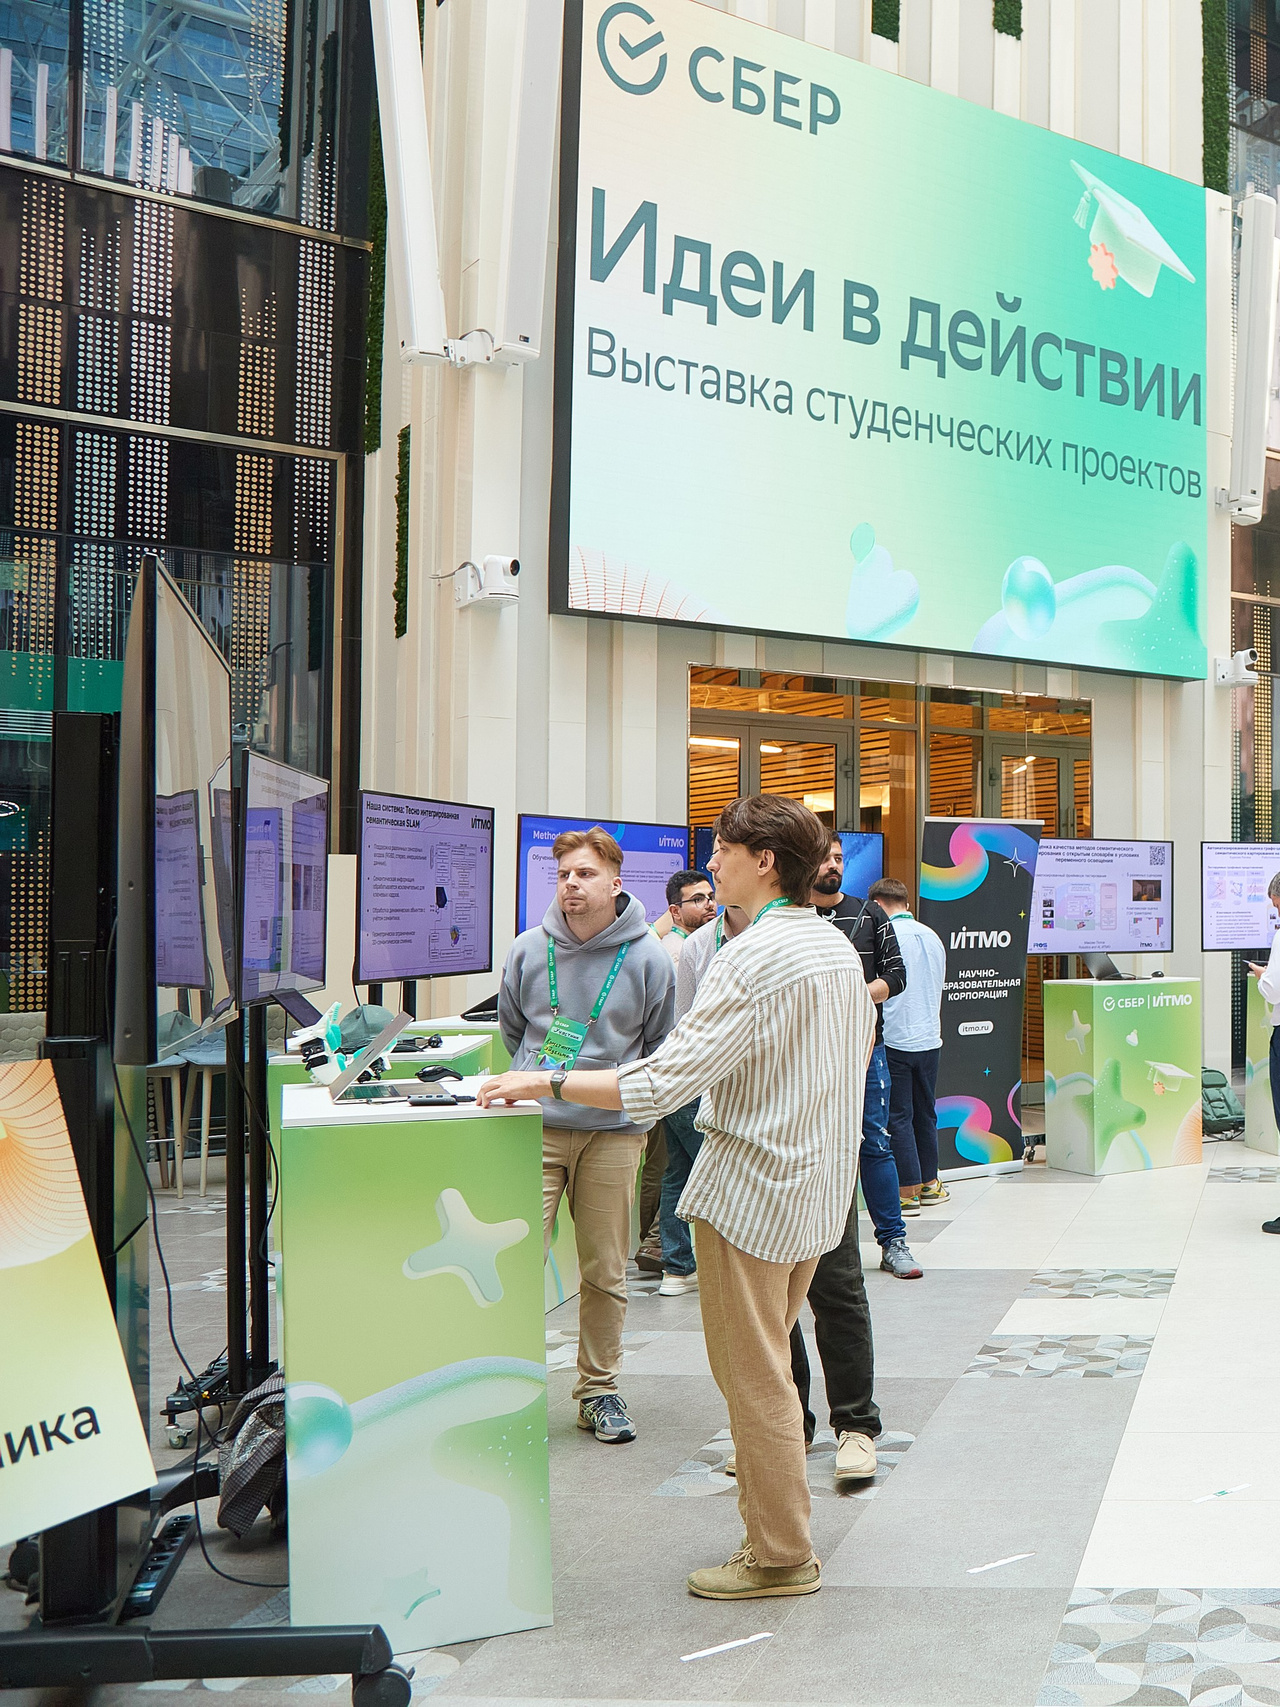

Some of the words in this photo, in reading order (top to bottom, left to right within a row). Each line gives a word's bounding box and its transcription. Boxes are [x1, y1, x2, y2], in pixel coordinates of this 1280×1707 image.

[688, 45, 842, 135] СБЕР
[589, 186, 815, 332] Идеи
[843, 278, 881, 346] в
[900, 291, 1202, 426] действии
[586, 326, 794, 416] Выставка
[806, 385, 1053, 468] студенческих
[1061, 440, 1202, 499] проектов
[366, 800, 381, 811] Наша
[405, 806, 420, 816] Тесно
[420, 810, 459, 820] интегрированная
[366, 816, 405, 827] семантическая
[406, 819, 420, 828] SLAM
[959, 969, 999, 978] НАУЧНО-
[943, 979, 1020, 990] БРАЗОВАТЕЛЬНАЯ
[948, 990, 1008, 1001] КОРПОРАЦИЯ
[1118, 998, 1144, 1008] СБЕР
[0, 1406, 100, 1468] ика
